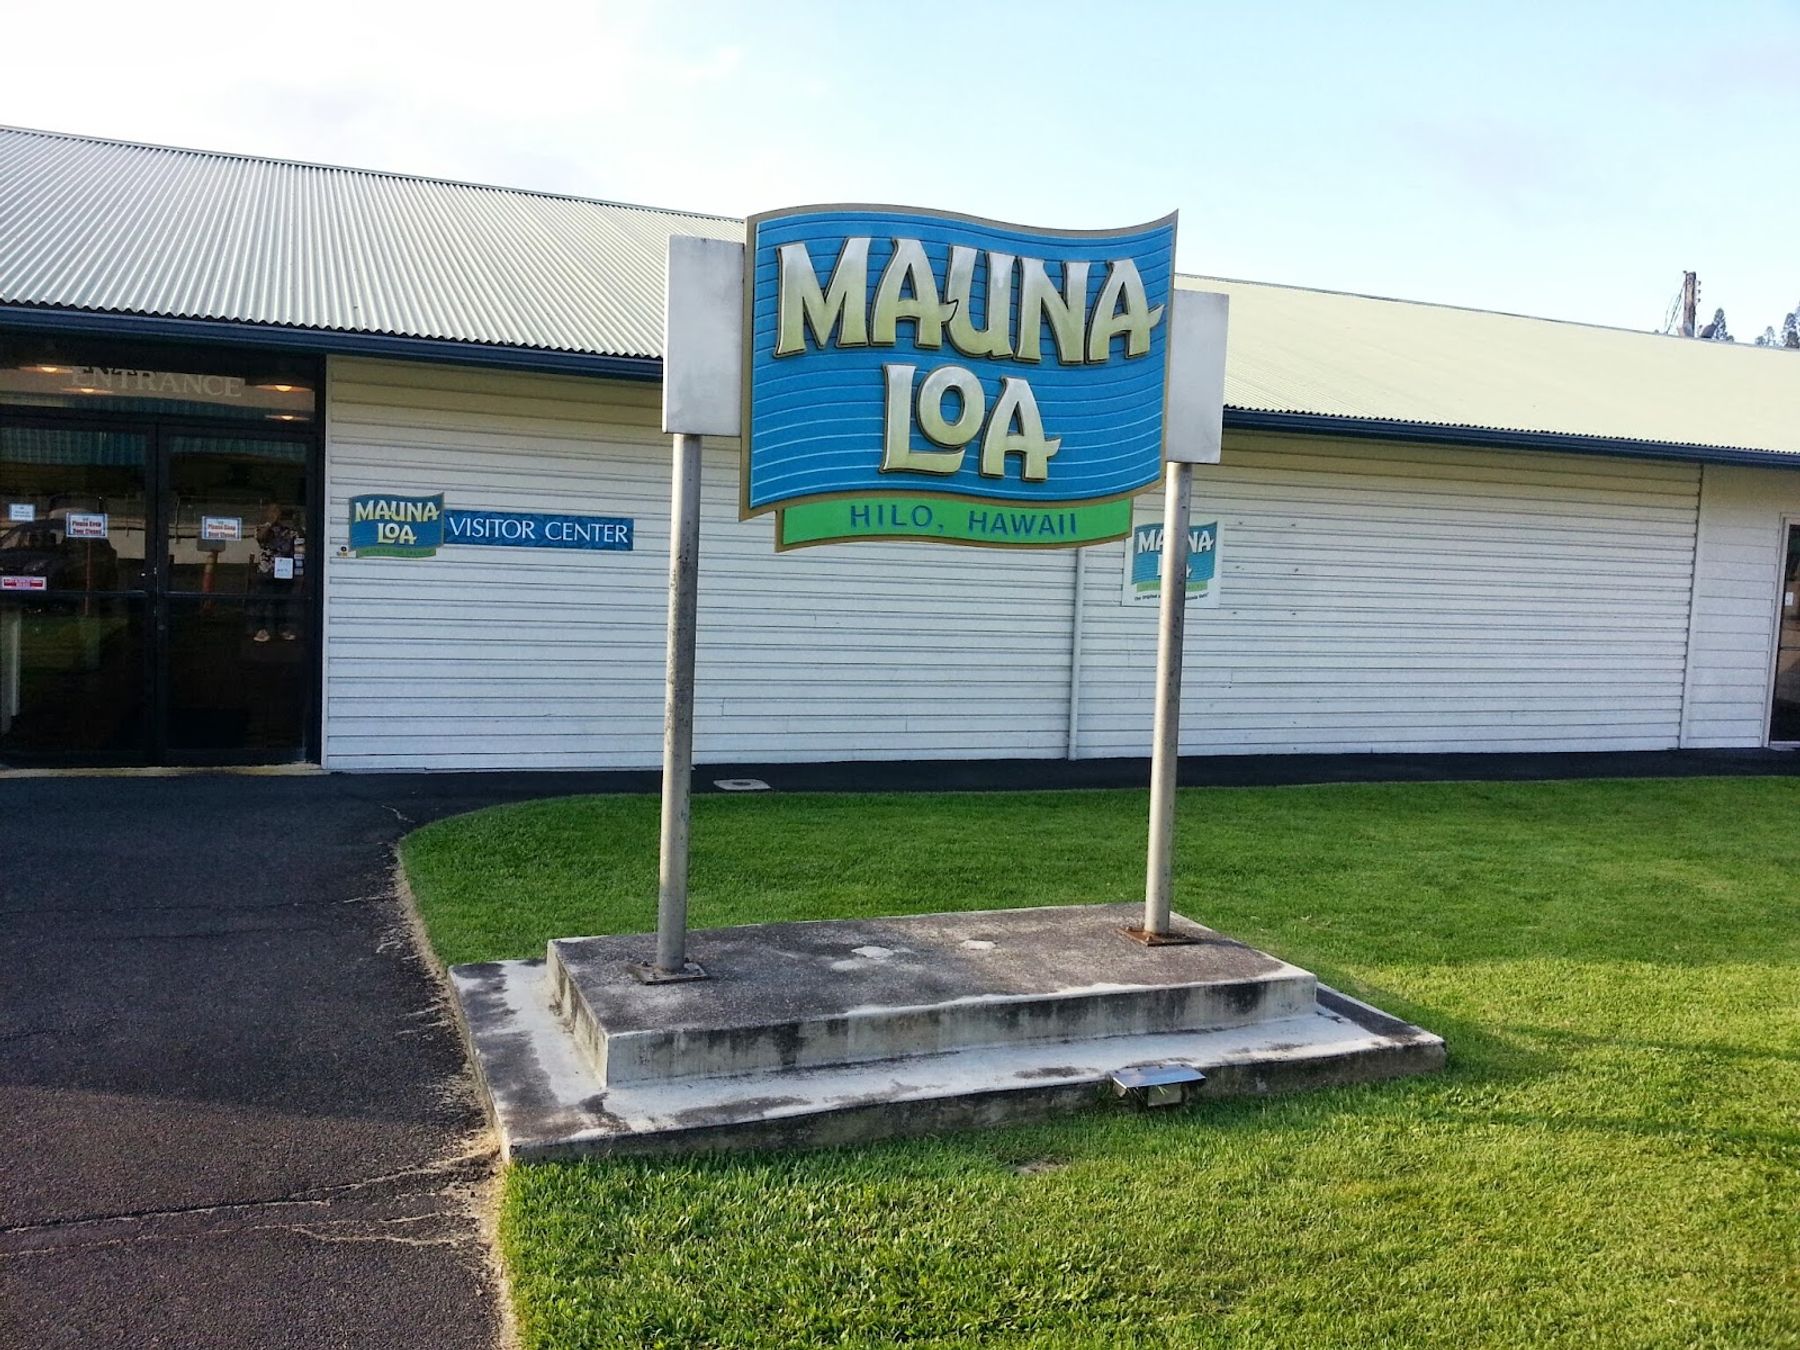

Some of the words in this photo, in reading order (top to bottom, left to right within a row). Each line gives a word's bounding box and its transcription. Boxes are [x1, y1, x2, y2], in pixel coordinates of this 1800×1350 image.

[773, 236, 1166, 365] MAUNA
[71, 366, 246, 398] ENTRANCE
[878, 363, 1063, 482] LOA
[354, 500, 440, 523] MAUNA
[850, 504, 944, 533] HILO,
[968, 510, 1077, 536] HAWAII
[377, 523, 417, 545] LOA
[449, 517, 536, 541] VISITOR
[545, 520, 629, 544] CENTER
[1137, 528, 1215, 554] MANA
